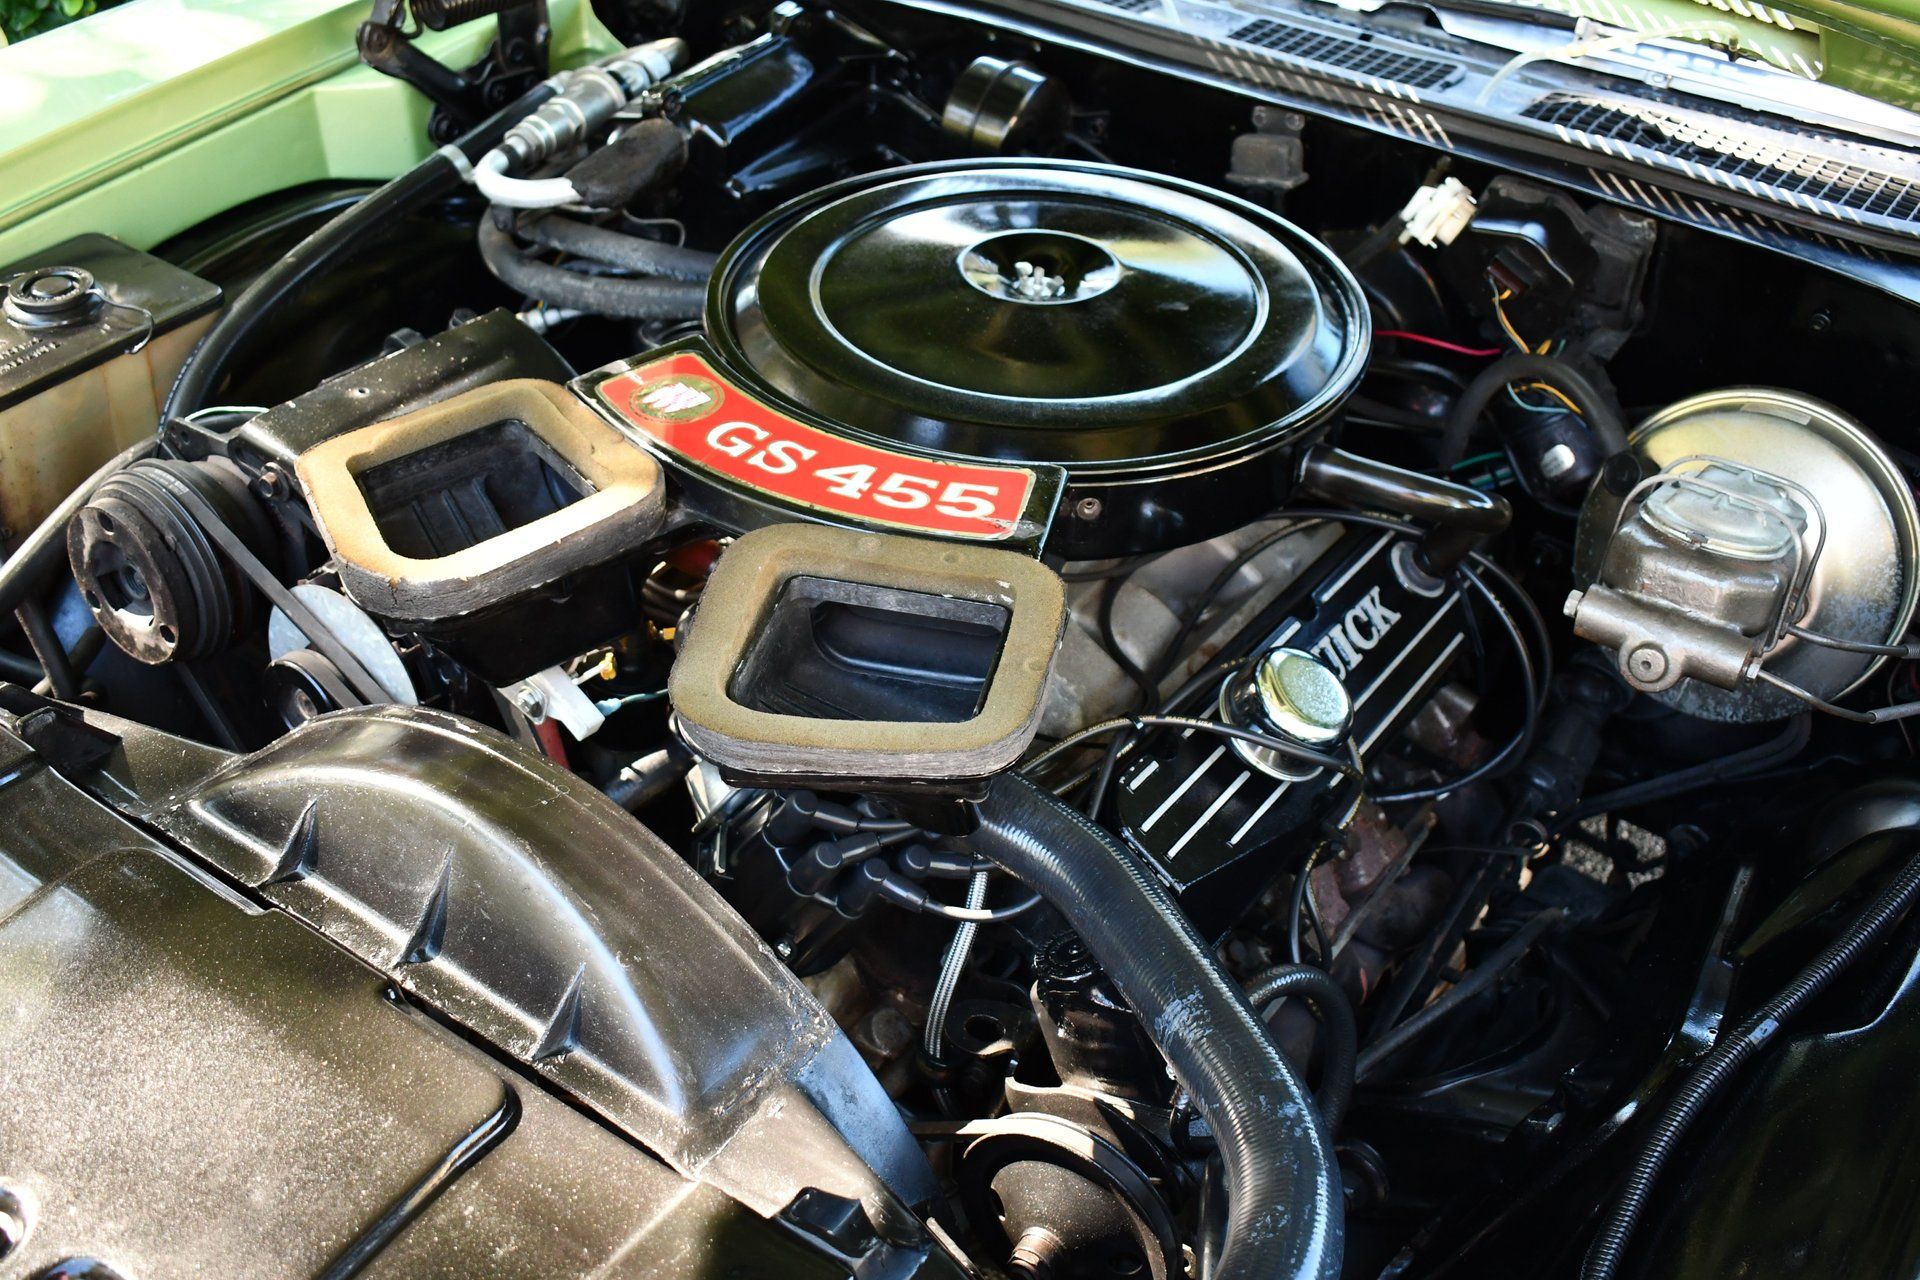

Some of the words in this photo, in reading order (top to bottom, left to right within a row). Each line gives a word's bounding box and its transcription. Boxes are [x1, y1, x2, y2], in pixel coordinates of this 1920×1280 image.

[706, 421, 818, 475] GS
[814, 464, 999, 518] 455
[1310, 585, 1402, 681] UICK
